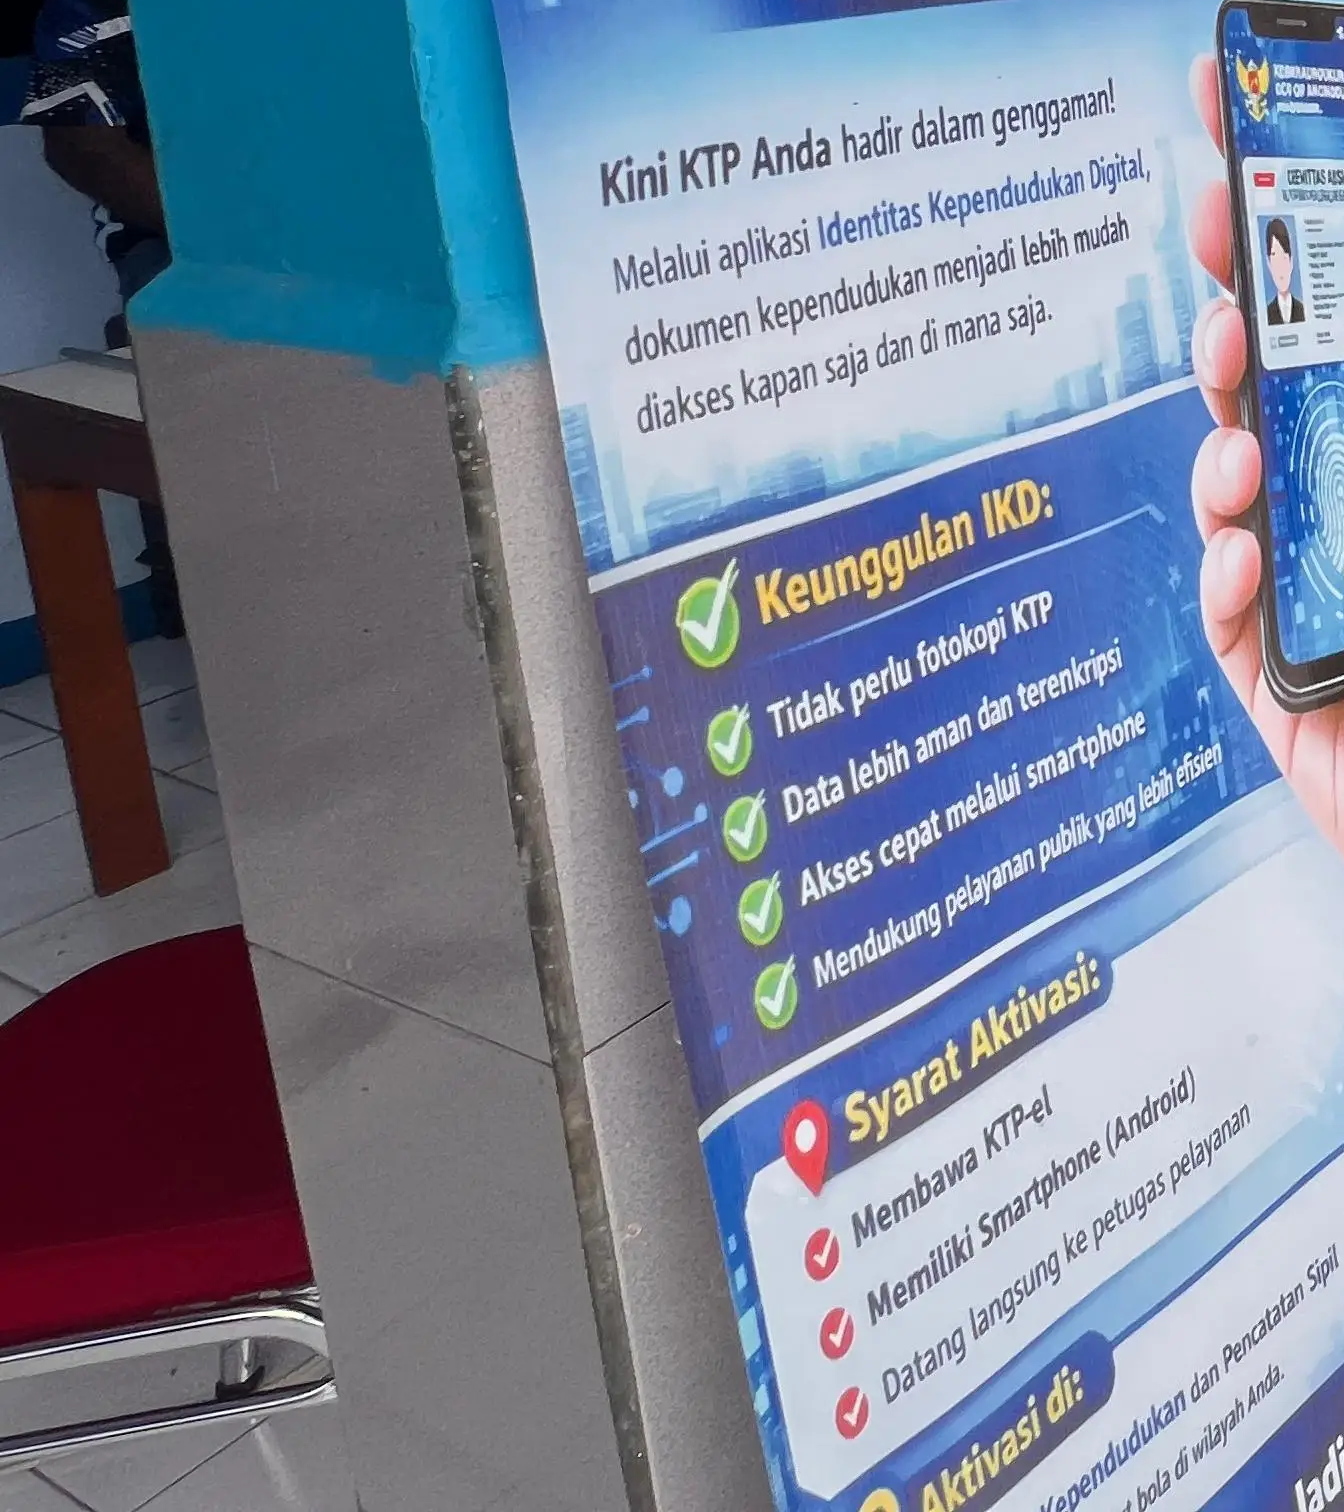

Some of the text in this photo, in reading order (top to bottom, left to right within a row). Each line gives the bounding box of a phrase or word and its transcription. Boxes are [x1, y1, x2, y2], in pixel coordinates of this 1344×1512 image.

[599, 77, 1117, 207] Kini KTP Anda hadir dalam genggaman!
[612, 148, 1152, 295] Melalui aplikasi Identitas Kependudukan Digital,
[625, 212, 1131, 366] dokumen kependudukan menjadi lebih mudah
[636, 292, 1054, 435] diakses kapan saja dan di mana saja.
[754, 478, 1055, 626] Keunggulan IKD:
[767, 588, 1054, 740] Tidak perlu fotokopi KTP
[783, 637, 1123, 826] Data lebih aman dan terenkripsi
[799, 710, 1148, 908] Akses cepat melalui smartphone
[812, 740, 1223, 990] Mendukung pelayanan publik yang lebih efisien
[843, 950, 1101, 1145] Syarat Aktivasi:
[850, 1084, 1054, 1248] Membawa KTP-el
[866, 1066, 1198, 1327] Memiliki Smartphone (Android)
[881, 1103, 1252, 1408] Datang langsung ke petugas pelayanan
[1190, 1363, 1220, 1403] dan
[1222, 1282, 1305, 1374] Pencatatan
[1306, 1242, 1340, 1292] Sipil
[922, 1364, 1084, 1512] Aktivasi di:
[1136, 1364, 1286, 1512] bola di wilayah Anda.
